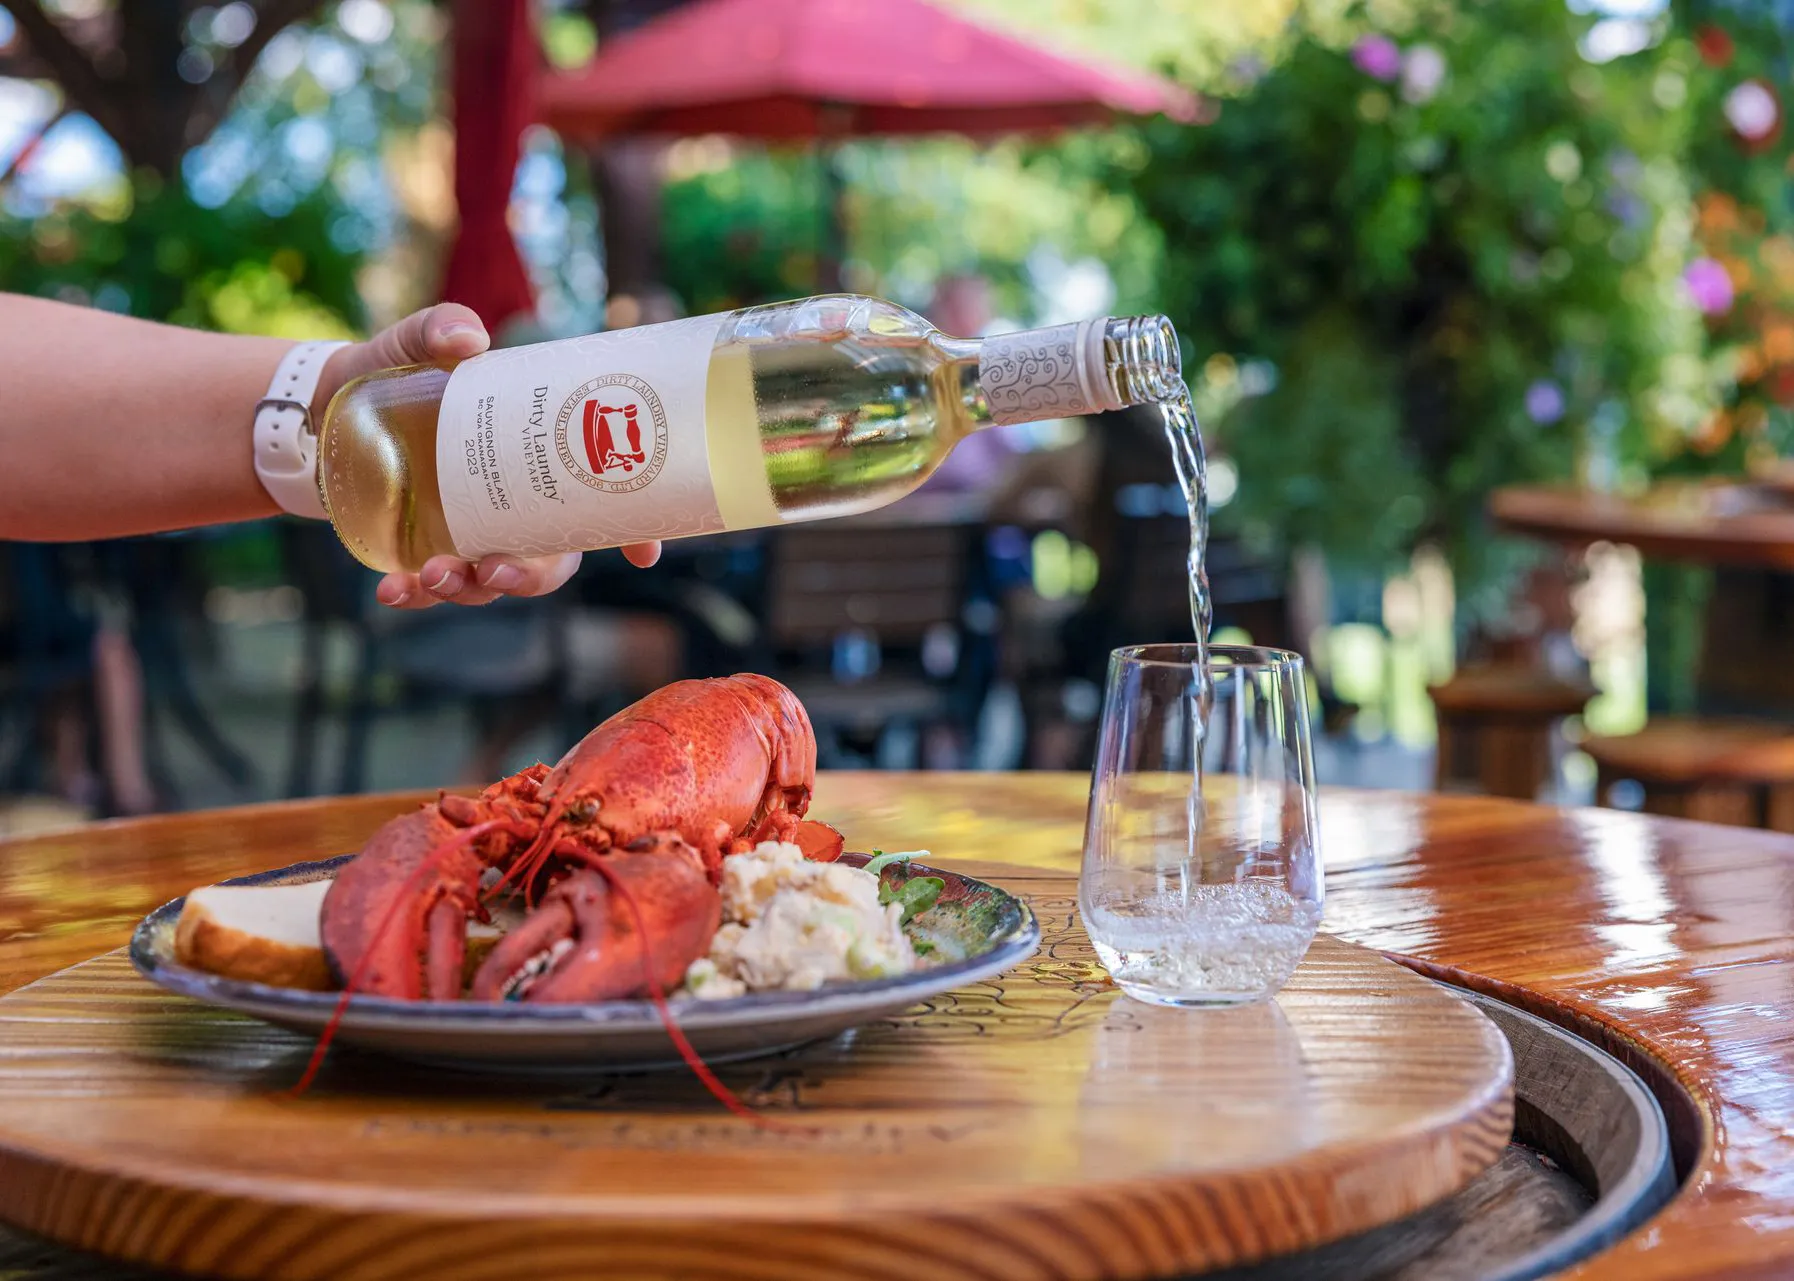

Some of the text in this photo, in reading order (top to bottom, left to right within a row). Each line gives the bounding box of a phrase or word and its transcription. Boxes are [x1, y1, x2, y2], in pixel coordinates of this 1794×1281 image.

[528, 385, 549, 427] Dirty
[596, 375, 632, 387] DIRTY
[633, 380, 666, 429] LAUNDRY
[465, 439, 479, 476] 2023
[476, 399, 501, 511] BC VQA OKANAGAN VALLEY
[485, 396, 511, 511] SAUVIGNON BLANC
[521, 427, 542, 492] VINEYARD
[557, 385, 604, 489] ESTABLISHED 2006
[637, 433, 666, 487] VINEYARD
